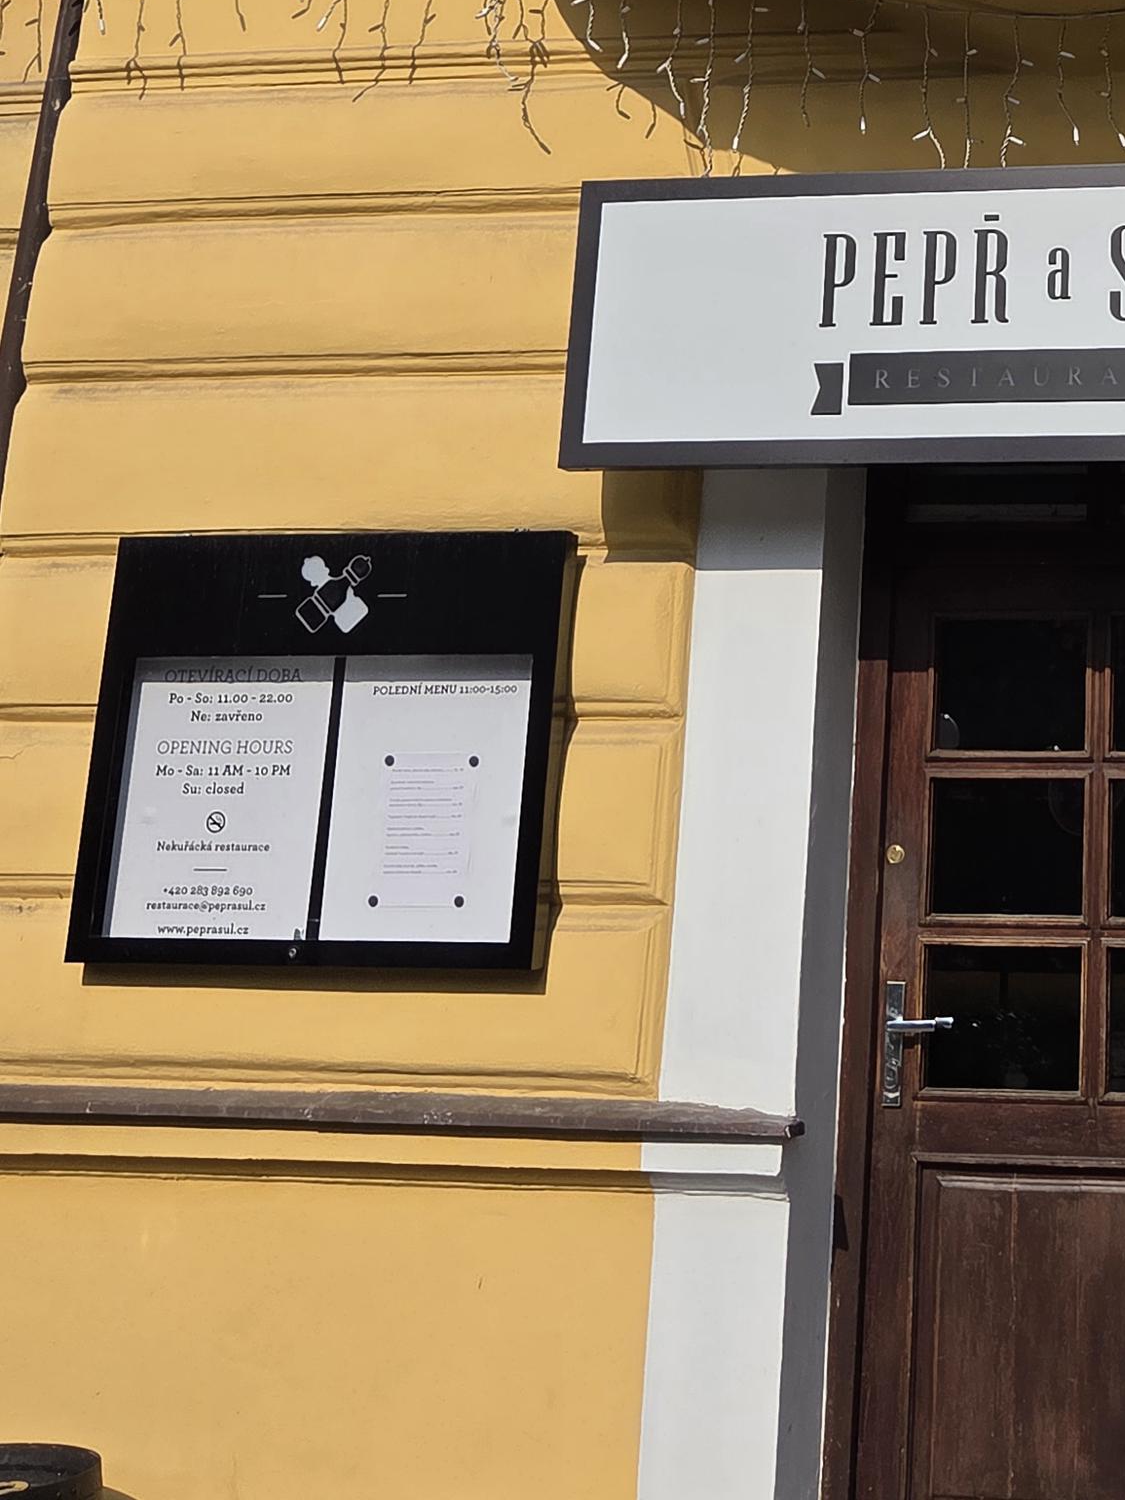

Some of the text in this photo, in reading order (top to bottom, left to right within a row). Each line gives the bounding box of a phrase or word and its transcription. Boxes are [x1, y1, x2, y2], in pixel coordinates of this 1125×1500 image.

[1047, 246, 1072, 300] a
[164, 665, 303, 683] OTEVÍRACÍ DOBA
[373, 682, 423, 696] POLEDNÍ
[424, 684, 457, 695] MENU
[169, 692, 184, 704] Po
[194, 692, 213, 704] So:
[217, 694, 248, 704] 11.00
[259, 693, 293, 703] 22.00
[190, 709, 263, 722] Ne: zavřeno
[157, 739, 294, 755] OPENING HOURS
[155, 765, 175, 776] Mo
[185, 764, 203, 776] Sa:
[207, 766, 219, 776] 11
[222, 765, 244, 776] AM
[255, 766, 269, 776] 10
[271, 764, 291, 776] PM
[182, 782, 245, 795] Su: closed
[156, 840, 270, 852] Nekuřácká restaurace
[190, 885, 209, 897] 283
[211, 885, 230, 897] 892
[232, 885, 253, 897] 690
[146, 900, 267, 913] restaurace@peprasul.cz
[157, 923, 249, 937] www.peprasul.cz
